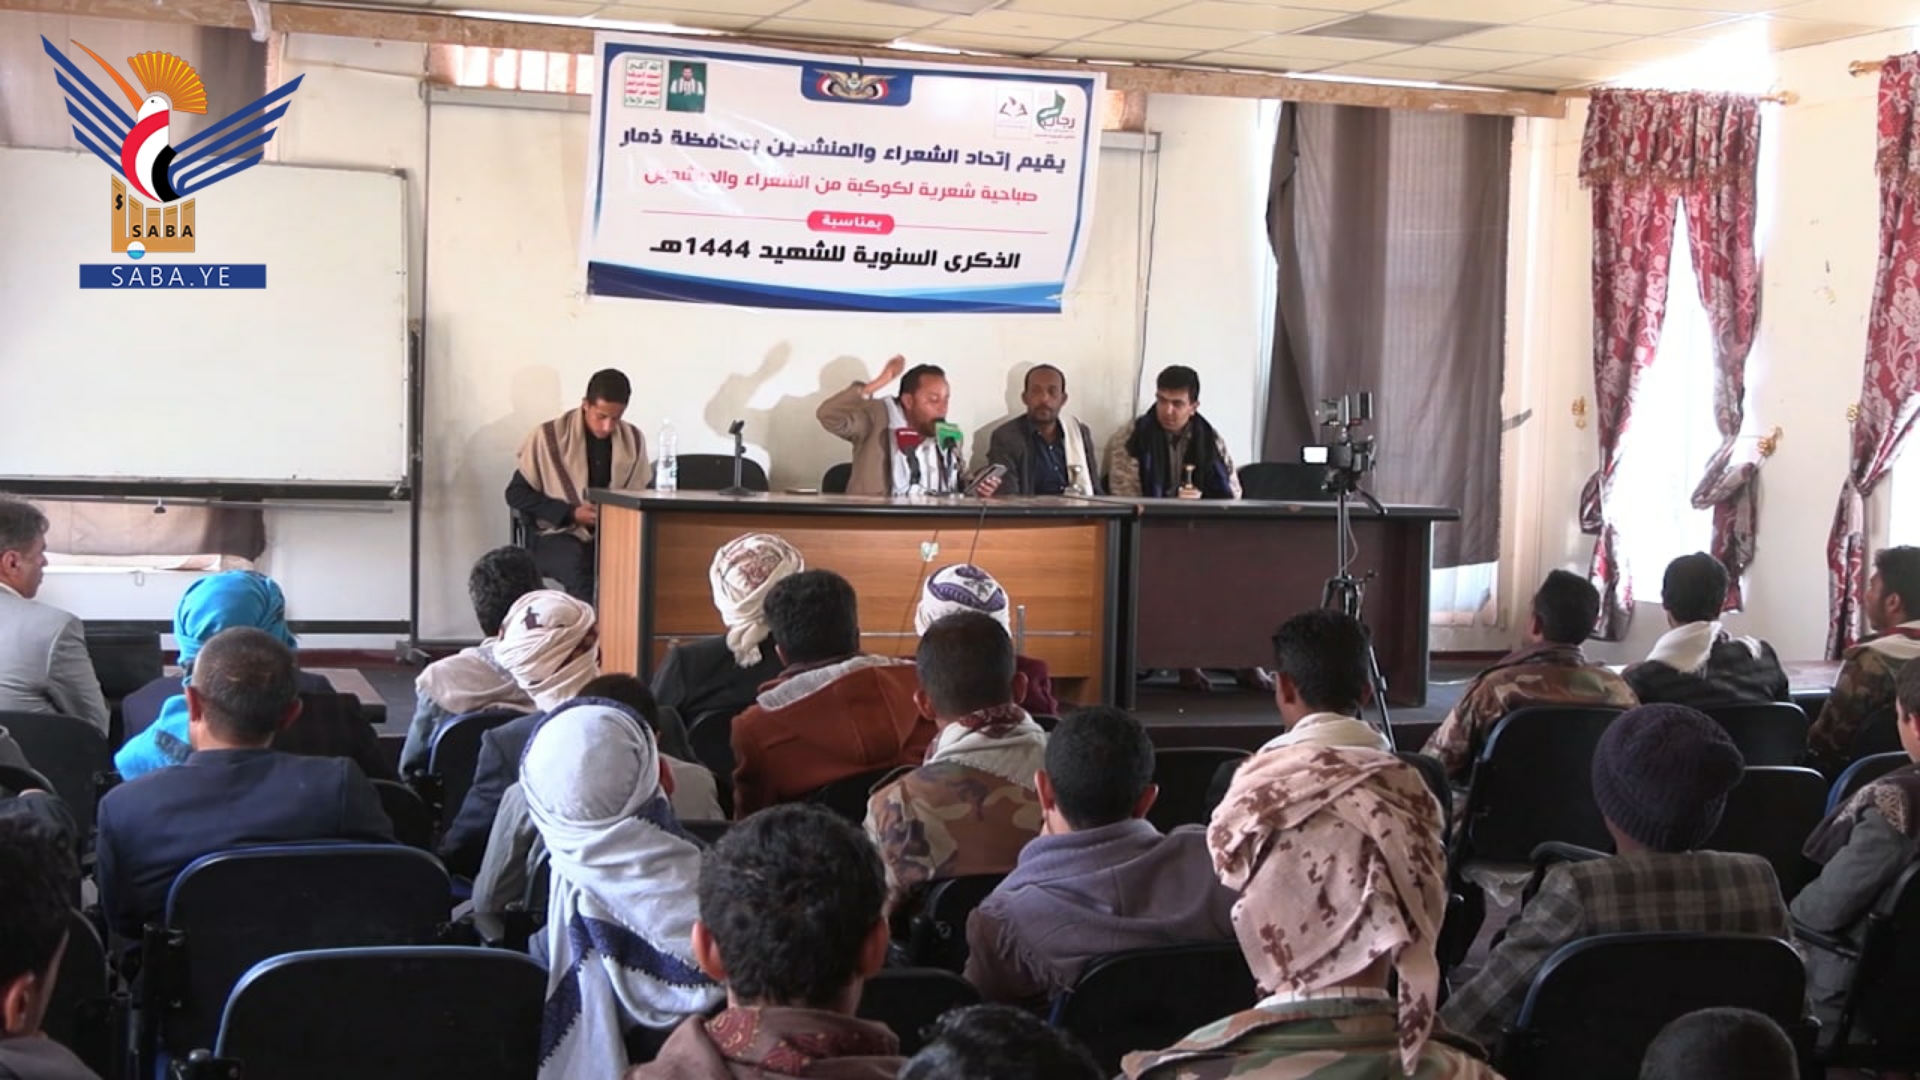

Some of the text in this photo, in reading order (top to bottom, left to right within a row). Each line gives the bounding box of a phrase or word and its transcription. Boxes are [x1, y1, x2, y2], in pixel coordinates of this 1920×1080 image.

[619, 127, 663, 147] ذمار
[767, 137, 876, 164] والمنشدين
[883, 144, 959, 165] الشعراء
[965, 150, 1011, 171] إتحاد
[1016, 153, 1066, 174] يقيم
[644, 165, 1038, 204] صباحية شعرية لكوكبة من الشعراء والمشدين
[821, 214, 882, 231] بمناسبة
[759, 239, 845, 265] للشهيد
[853, 245, 937, 270] السنوية
[944, 251, 1021, 273] الذكرى
